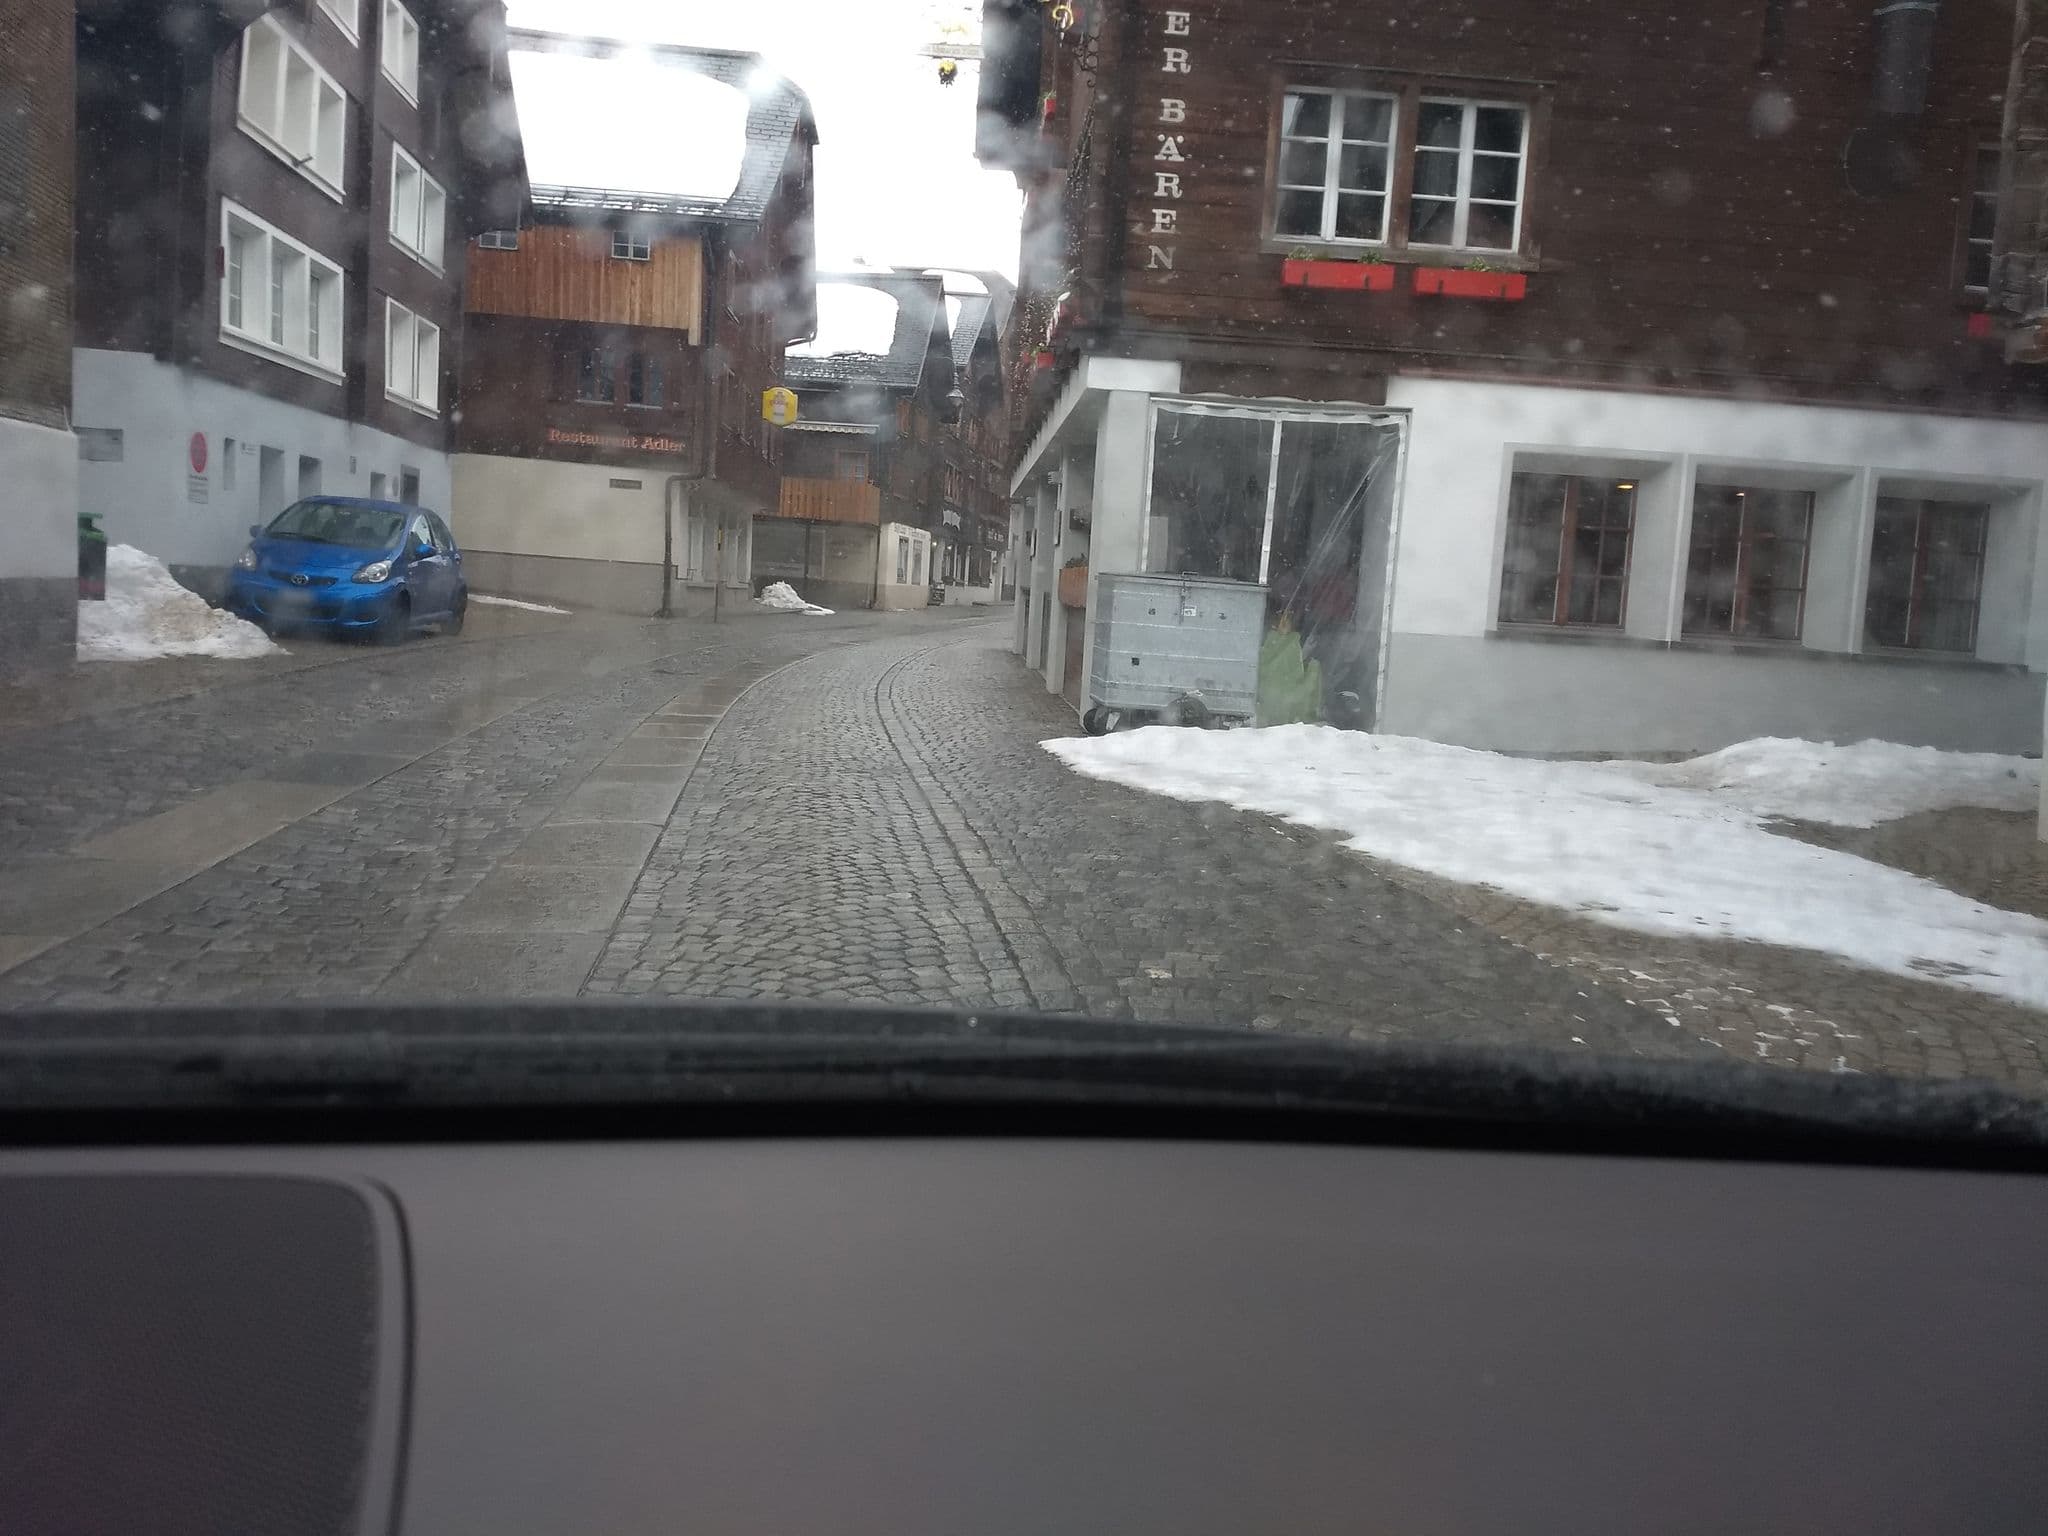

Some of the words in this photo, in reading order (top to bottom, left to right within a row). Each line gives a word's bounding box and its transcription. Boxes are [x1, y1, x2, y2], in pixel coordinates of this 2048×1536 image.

[1147, 98, 1186, 270] BÄREN
[549, 428, 638, 449] Restaunt
[640, 435, 686, 451] Adler
